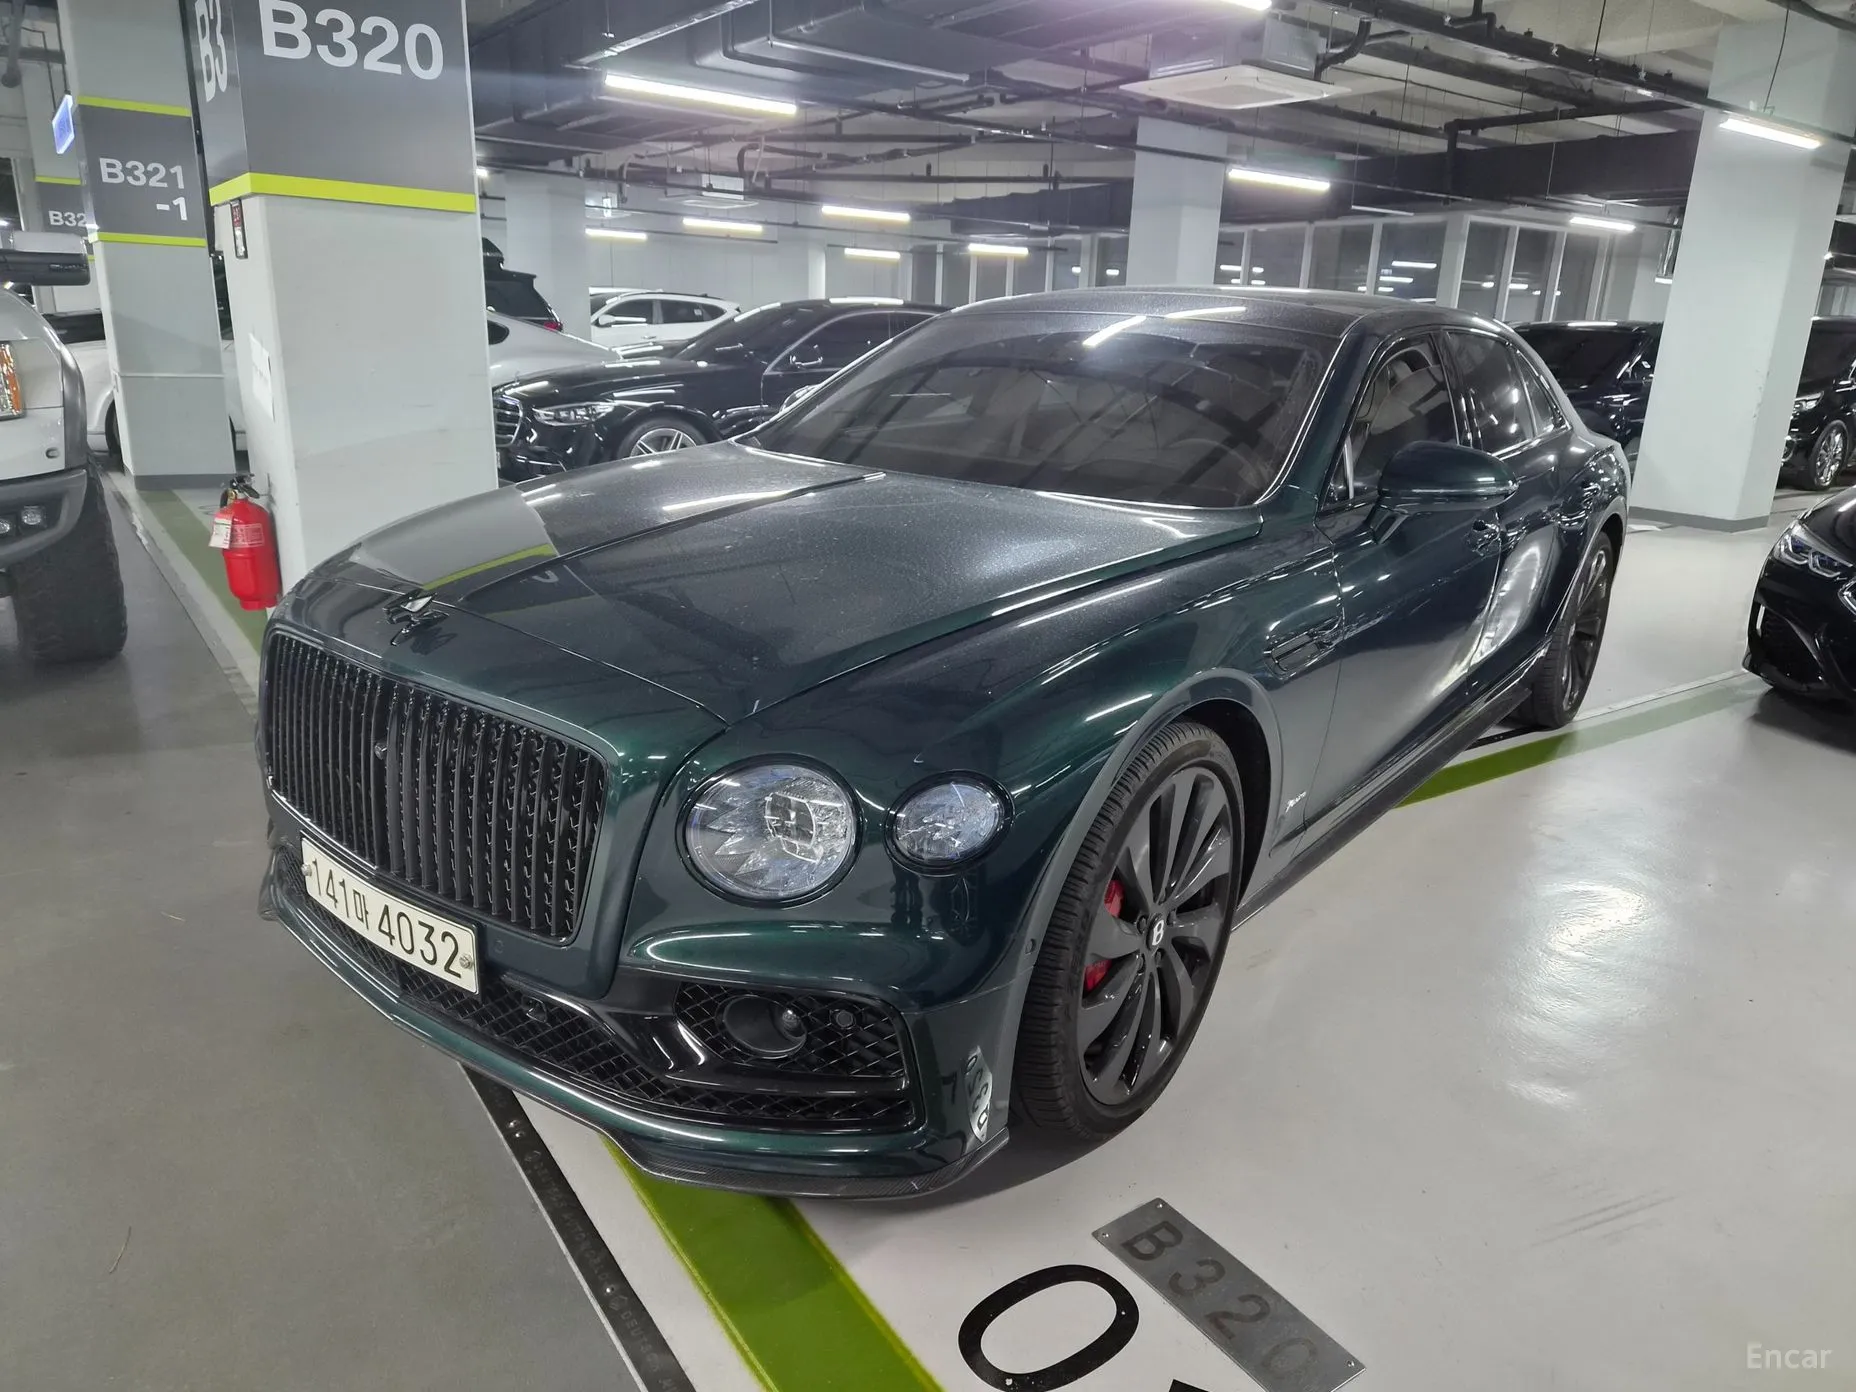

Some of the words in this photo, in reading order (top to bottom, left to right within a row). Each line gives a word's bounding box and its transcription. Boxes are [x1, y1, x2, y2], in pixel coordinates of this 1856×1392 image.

[259, 0, 444, 80] B320
[99, 157, 185, 189] B321
[48, 210, 89, 227] B32
[156, 196, 188, 221] -1
[311, 858, 369, 930] 141마
[378, 903, 462, 978] 4032
[1120, 1220, 1318, 1377] B320
